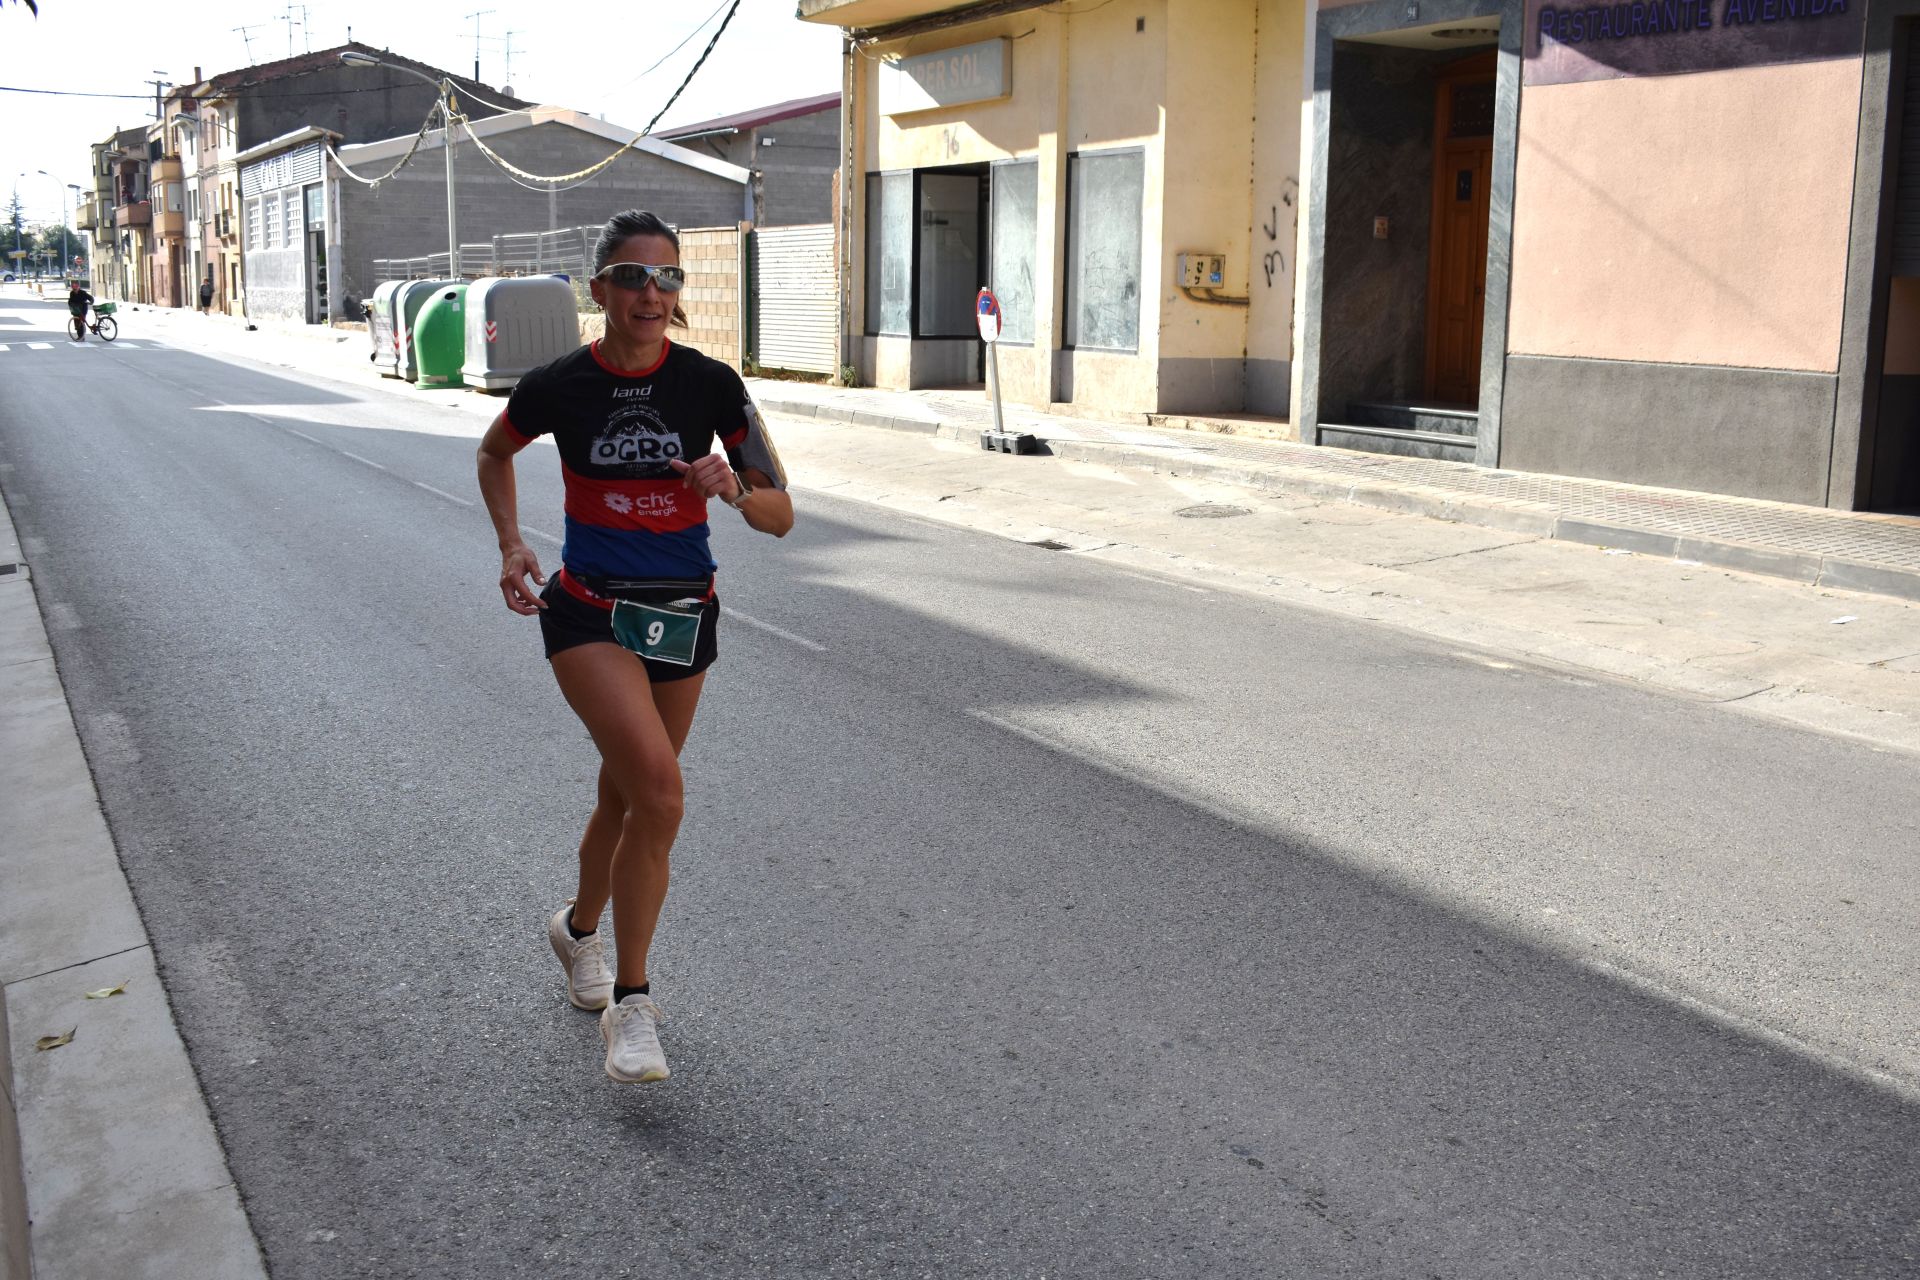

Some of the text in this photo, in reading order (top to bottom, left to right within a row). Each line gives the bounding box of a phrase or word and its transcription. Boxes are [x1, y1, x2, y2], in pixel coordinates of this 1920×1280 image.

[1540, 2, 1710, 45] RESTAURANTE
[612, 385, 653, 399] land
[598, 438, 680, 461] OGRO
[636, 492, 675, 508] chc
[646, 621, 665, 646] 9
